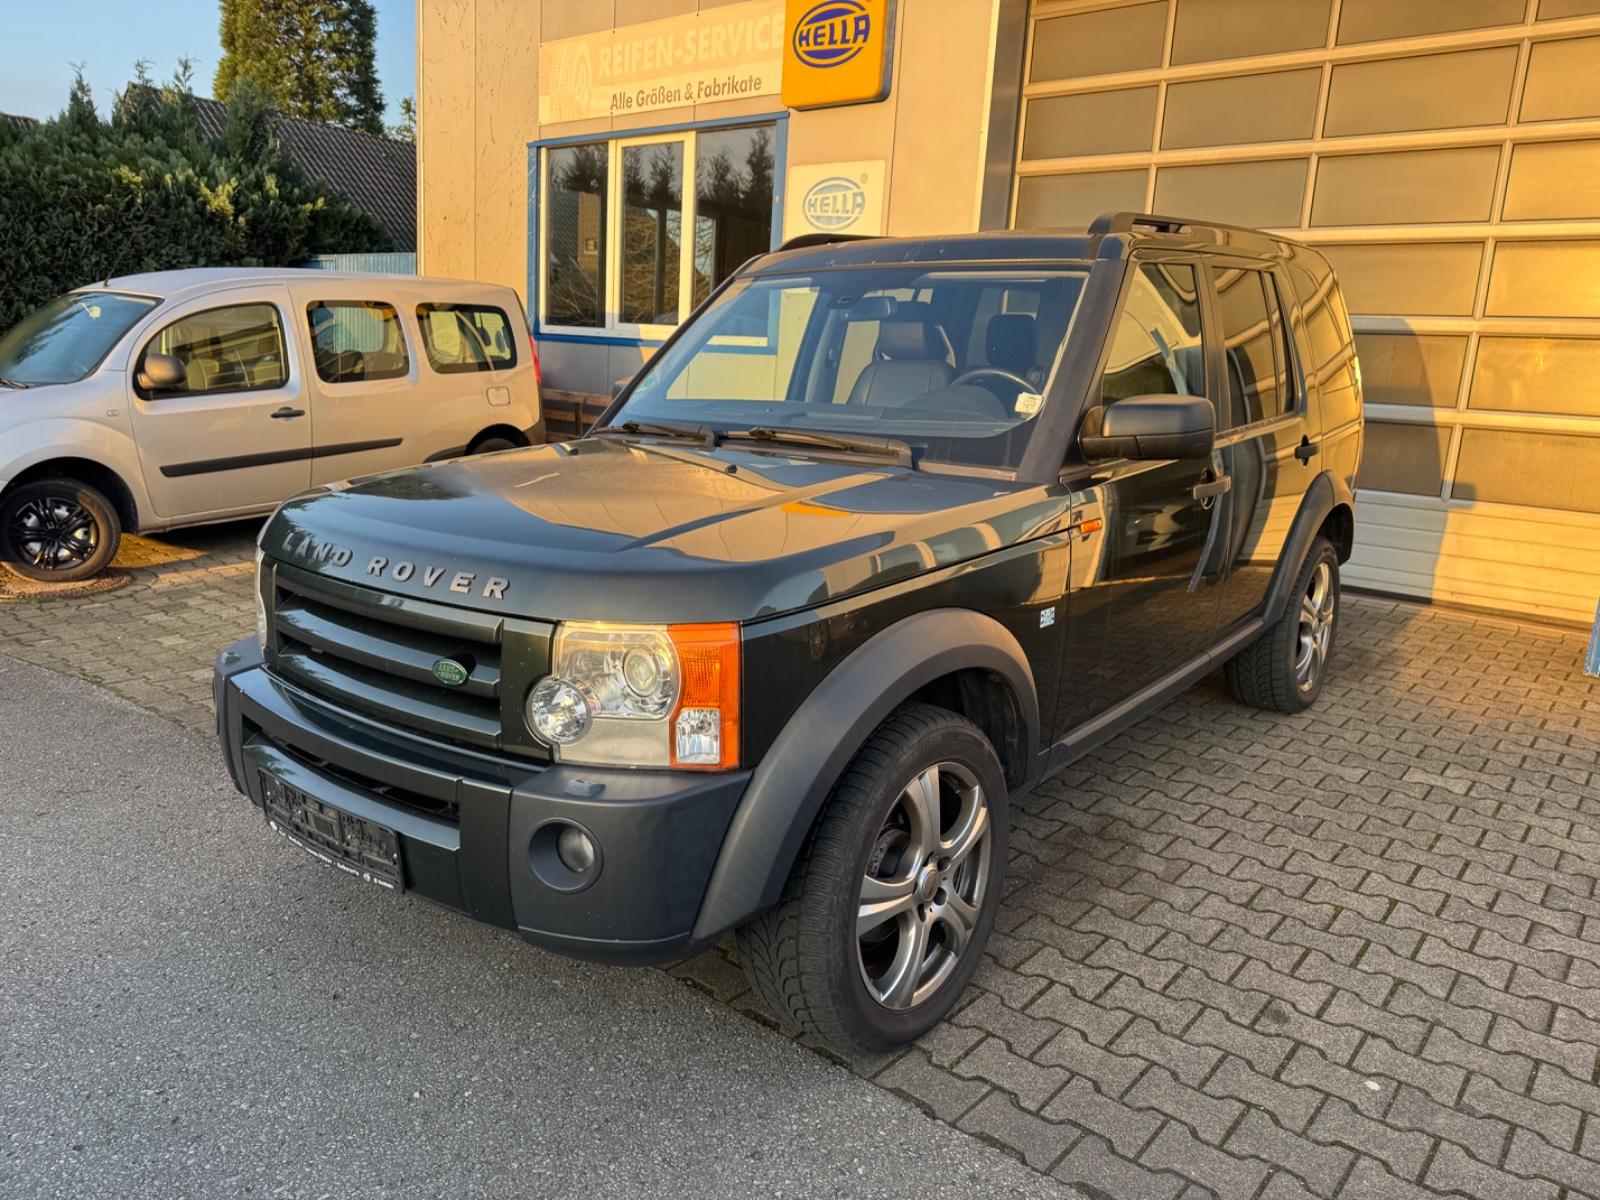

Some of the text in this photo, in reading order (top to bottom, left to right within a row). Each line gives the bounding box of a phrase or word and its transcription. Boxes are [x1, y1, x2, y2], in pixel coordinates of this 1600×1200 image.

[598, 13, 785, 78] REIFEN-SERVICE
[798, 13, 870, 47] HELLA
[610, 75, 762, 110] Alle Größen & Fabrikate
[807, 191, 865, 215] HELLA
[282, 532, 510, 600] LAND ROVER
